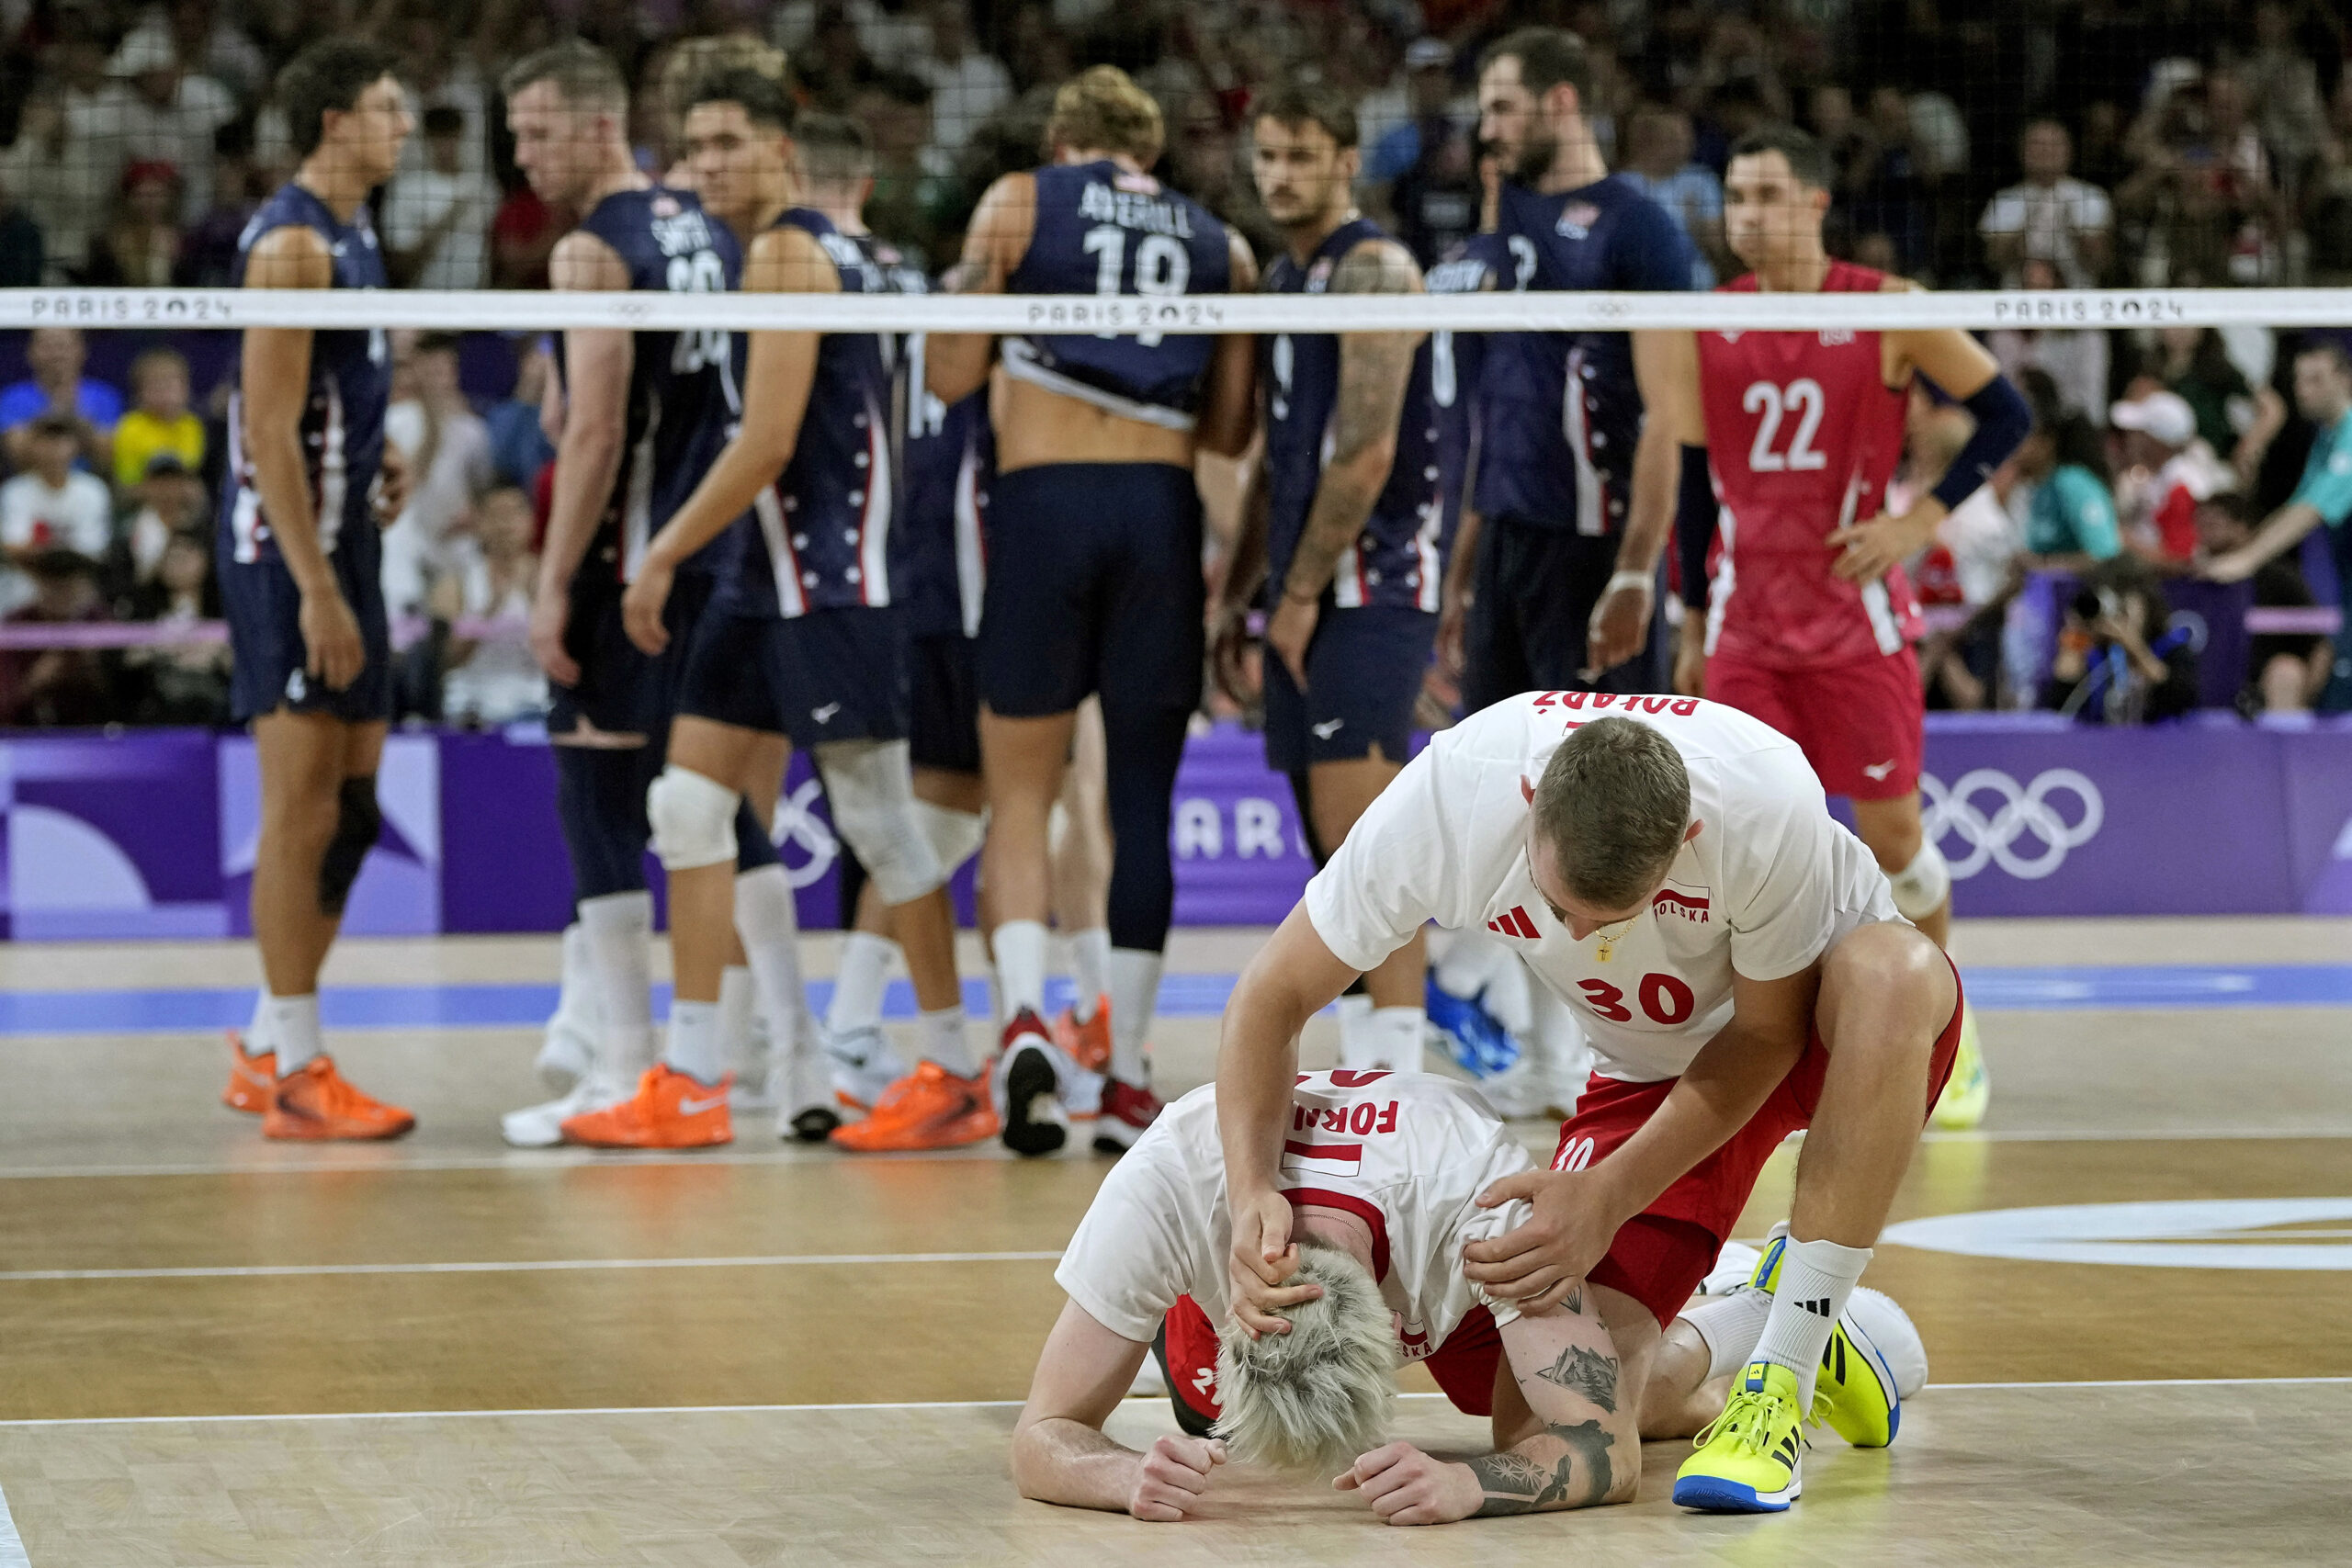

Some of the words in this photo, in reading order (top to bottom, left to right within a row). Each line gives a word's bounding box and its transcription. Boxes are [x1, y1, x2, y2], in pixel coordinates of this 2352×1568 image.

[32, 295, 128, 320] PARIS
[143, 295, 231, 320] 2024
[1028, 301, 1125, 326] PARIS
[1136, 301, 1225, 326] 2024
[1995, 298, 2086, 321] PARIS
[2100, 297, 2182, 321] 2024
[1743, 378, 1827, 472] 22
[1576, 972, 1695, 1025] 30
[1555, 1136, 1595, 1172] 30
